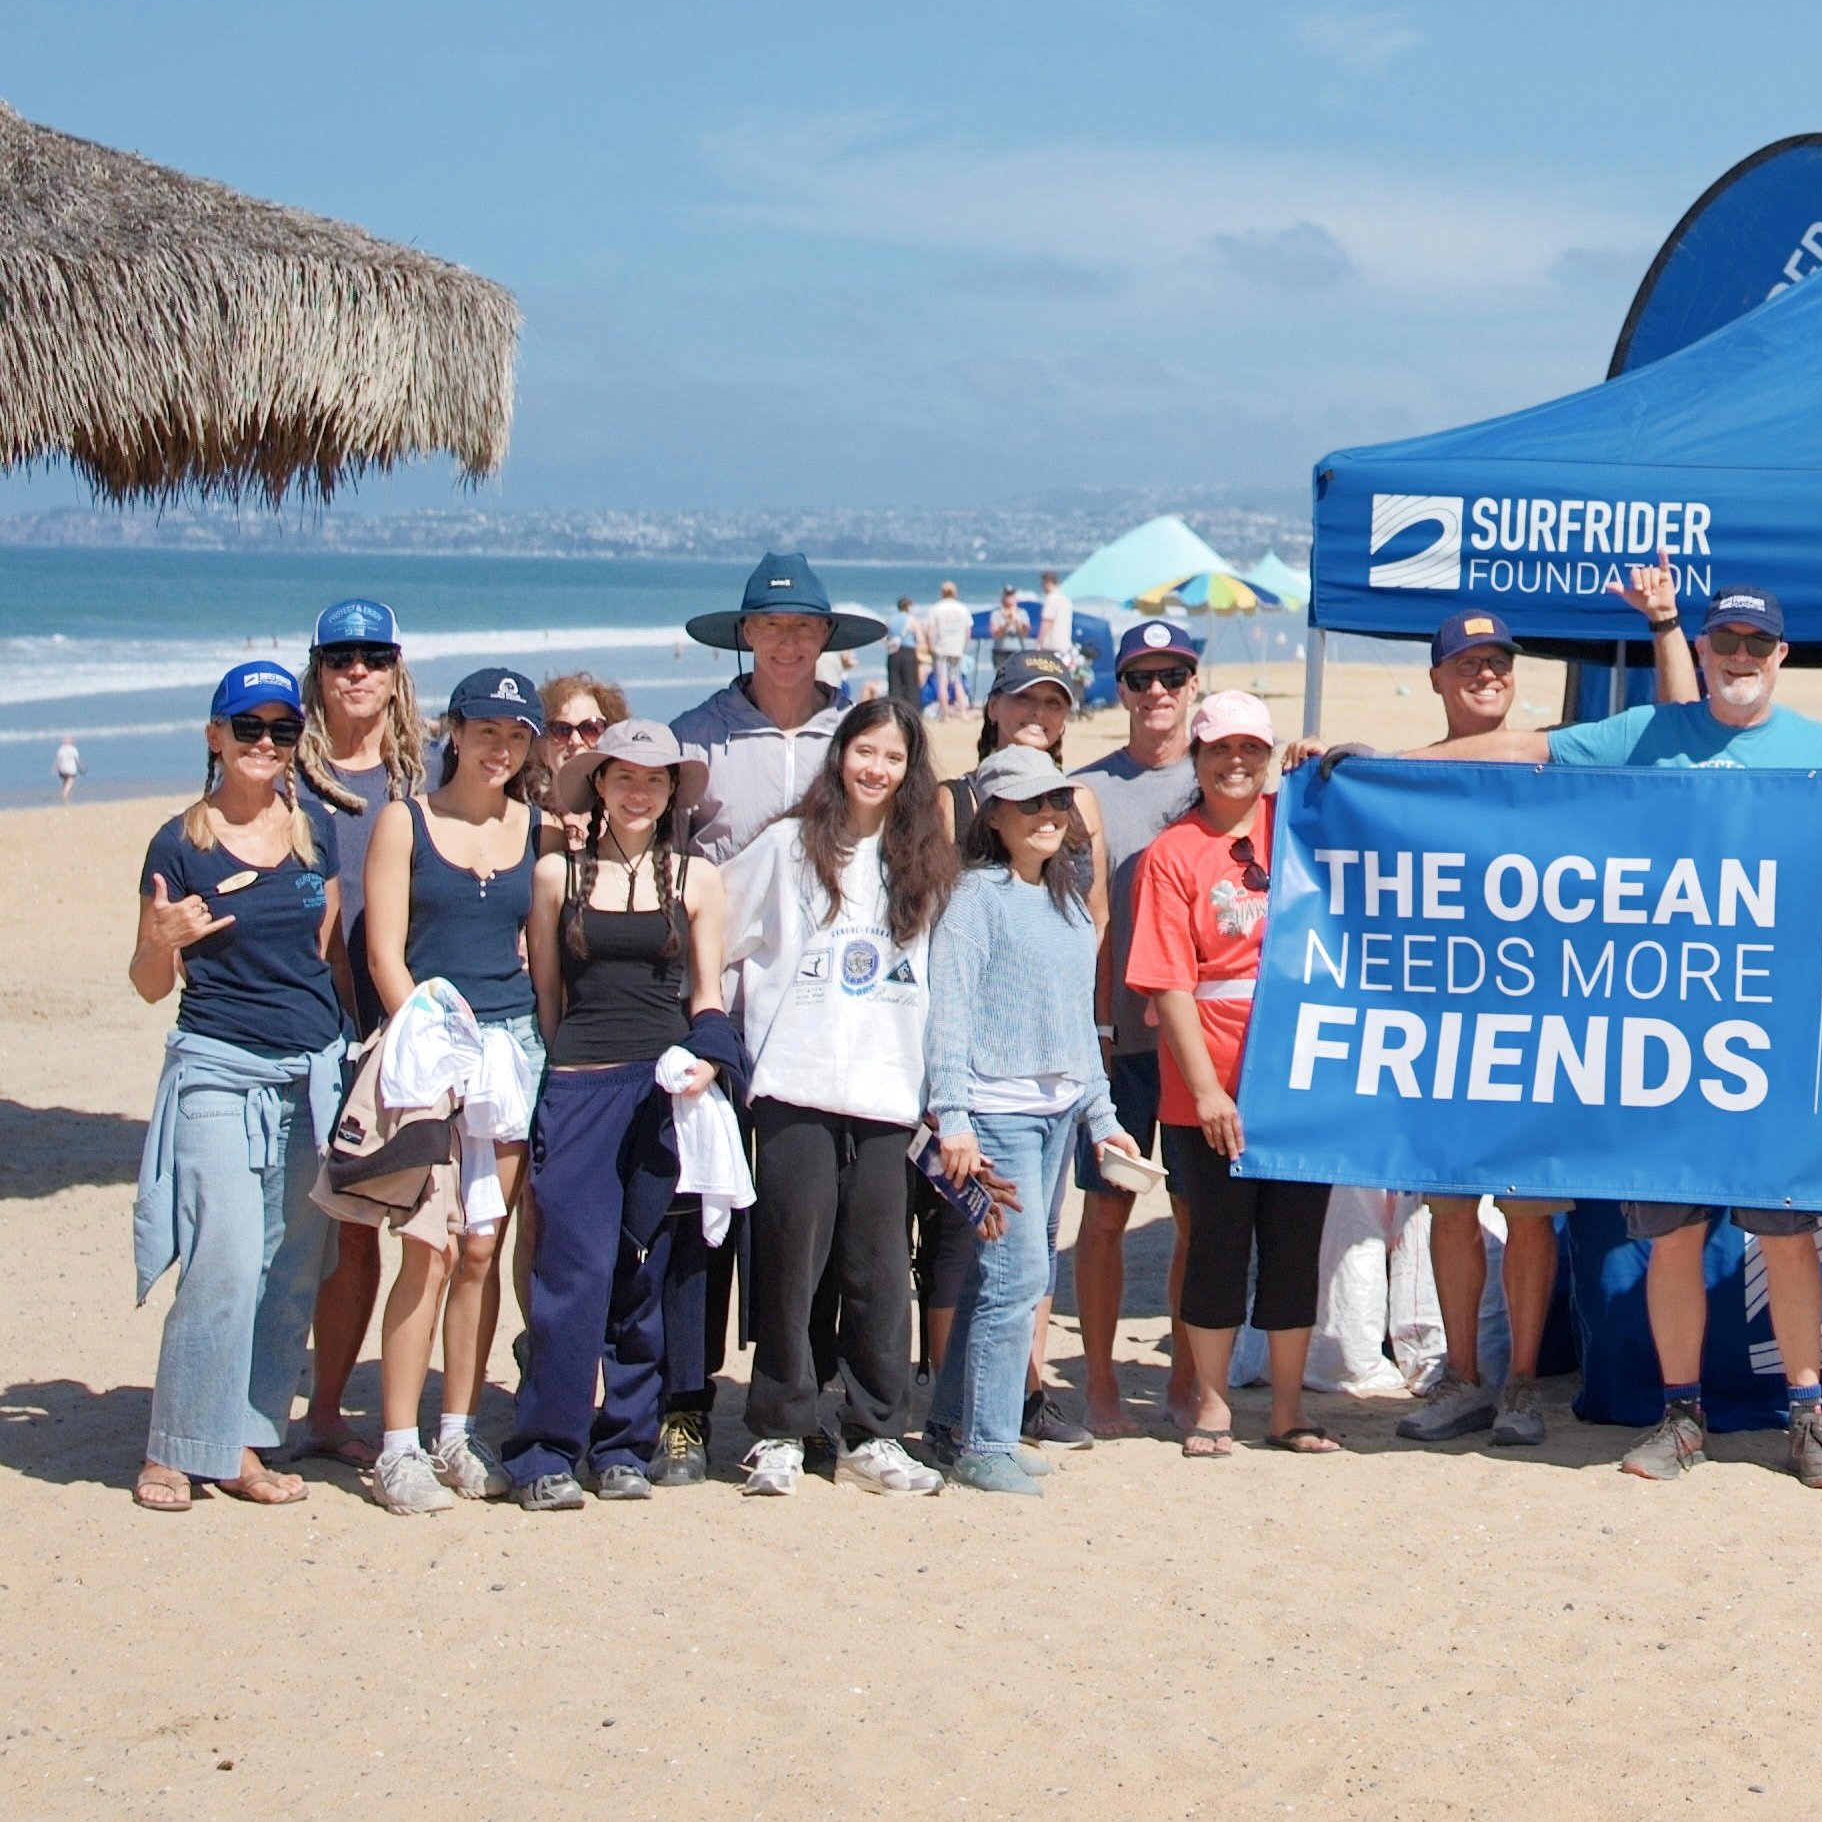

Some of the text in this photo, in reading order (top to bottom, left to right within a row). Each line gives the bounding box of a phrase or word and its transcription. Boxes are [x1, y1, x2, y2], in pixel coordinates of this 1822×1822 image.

[1470, 497, 1712, 556] SURFRIDER
[1468, 559, 1711, 597] FOUNDAN
[1314, 849, 1777, 928] THE OCEAN
[1303, 929, 1775, 1003] NEEDS MORE
[1288, 1002, 1772, 1113] FRIENDS
